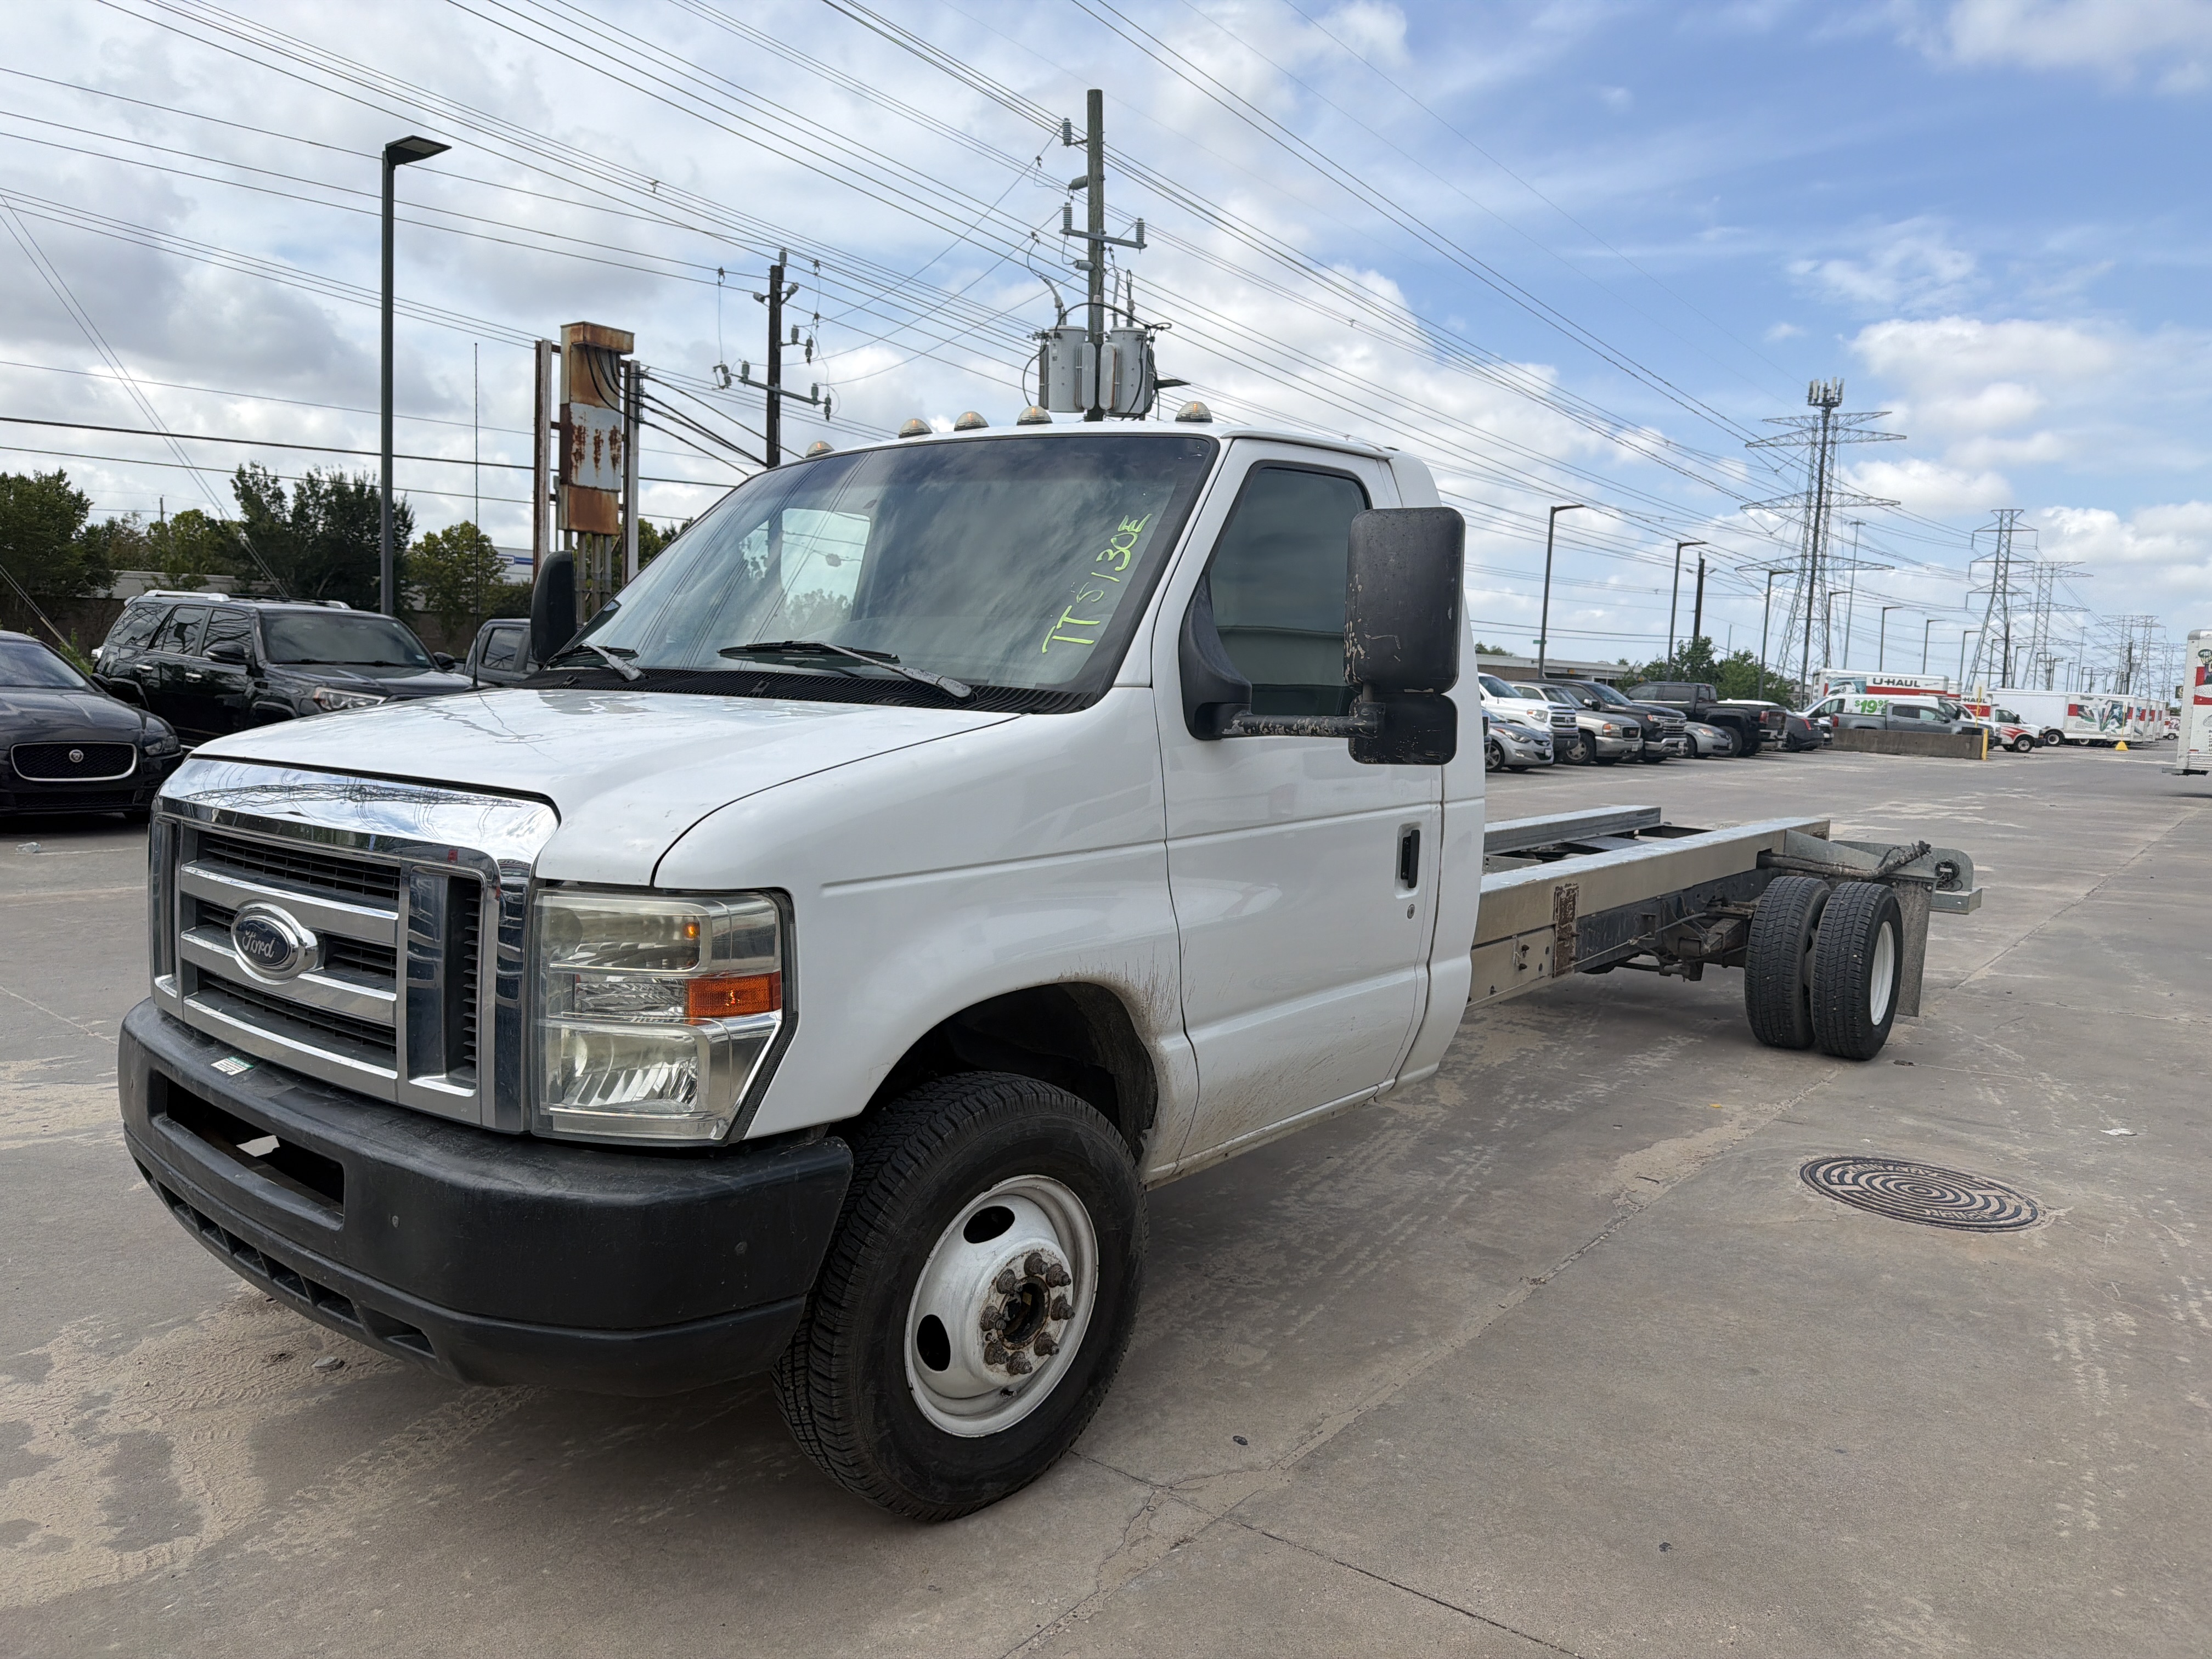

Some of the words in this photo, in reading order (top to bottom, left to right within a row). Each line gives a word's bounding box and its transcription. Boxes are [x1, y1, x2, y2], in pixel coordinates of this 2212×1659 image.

[1872, 678, 1921, 687] U-HAUL
[242, 923, 276, 958] Ford
[1927, 1209, 1997, 1220] SEWER
